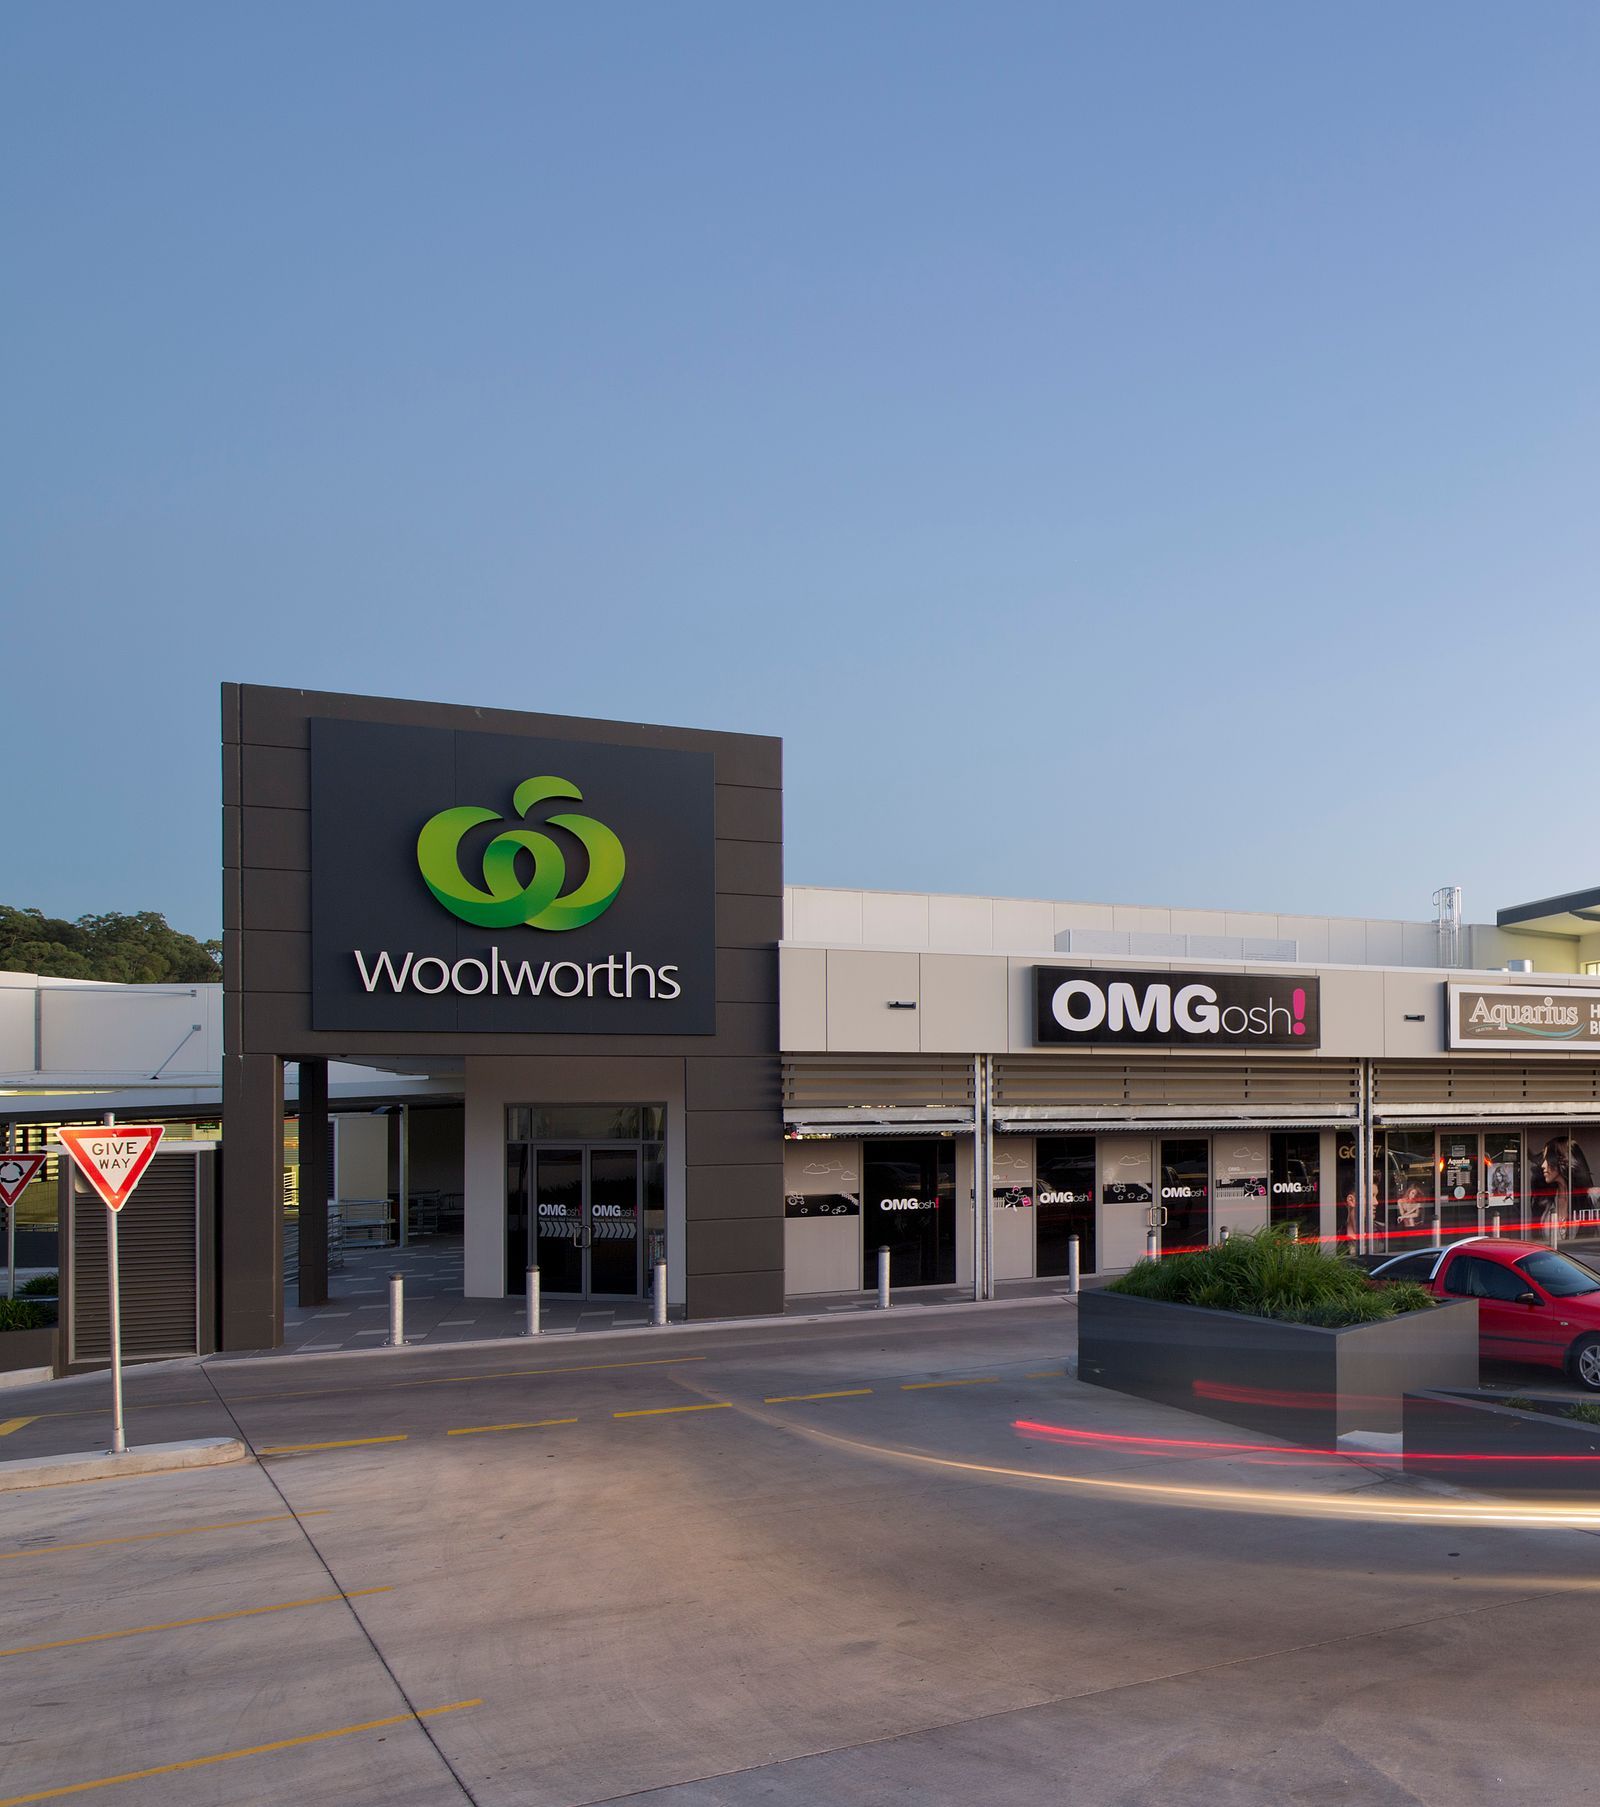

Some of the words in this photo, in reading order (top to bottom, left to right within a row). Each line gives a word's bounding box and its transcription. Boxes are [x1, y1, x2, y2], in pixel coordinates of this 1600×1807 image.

[354, 946, 682, 999] Woolworths
[1051, 979, 1306, 1036] OMGosh!
[1469, 996, 1579, 1031] Aquarius
[92, 1141, 138, 1155] GIVE
[99, 1158, 130, 1169] WAY
[1161, 1185, 1207, 1198] OMGosh!
[1273, 1182, 1317, 1194] OMGosh!
[1040, 1190, 1093, 1203] OMGosh!
[880, 1197, 940, 1211] OMGosh!
